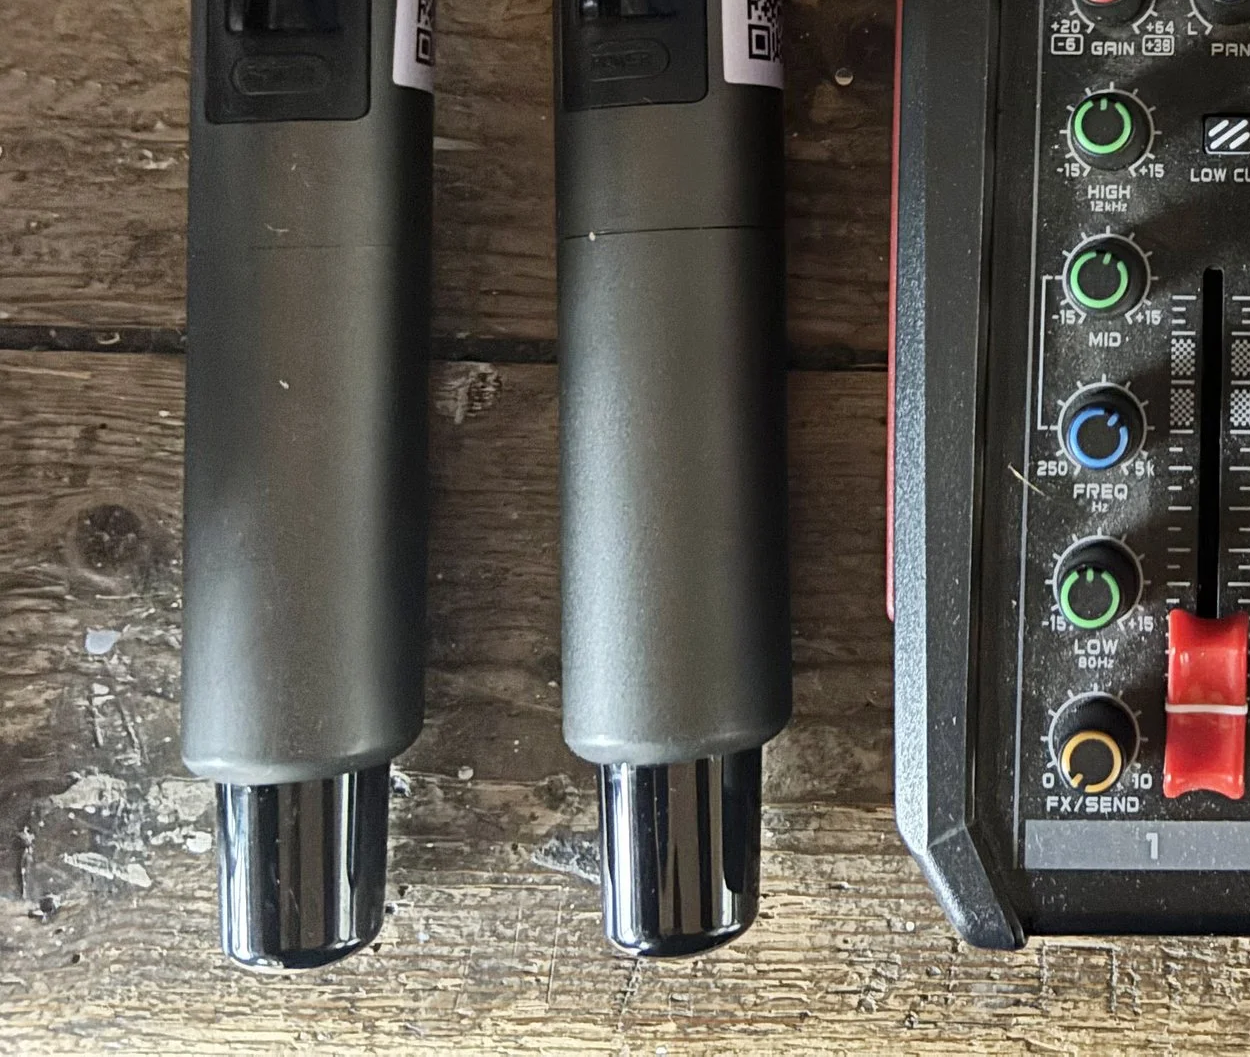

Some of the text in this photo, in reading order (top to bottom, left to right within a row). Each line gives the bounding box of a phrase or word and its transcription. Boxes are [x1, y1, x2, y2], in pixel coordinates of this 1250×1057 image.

[1050, 20, 1080, 33] +20
[1091, 42, 1135, 56] GAIN
[1211, 43, 1250, 57] PAN
[1190, 169, 1226, 182] LOW
[1088, 185, 1131, 199] HIGH
[1089, 332, 1122, 347] MID
[1037, 461, 1068, 476] 250
[1073, 484, 1128, 500] FREQ
[1092, 501, 1109, 512] Hz
[1074, 639, 1118, 655] LOW
[1047, 795, 1140, 813] FX/SEND
[1146, 832, 1159, 860] 1
